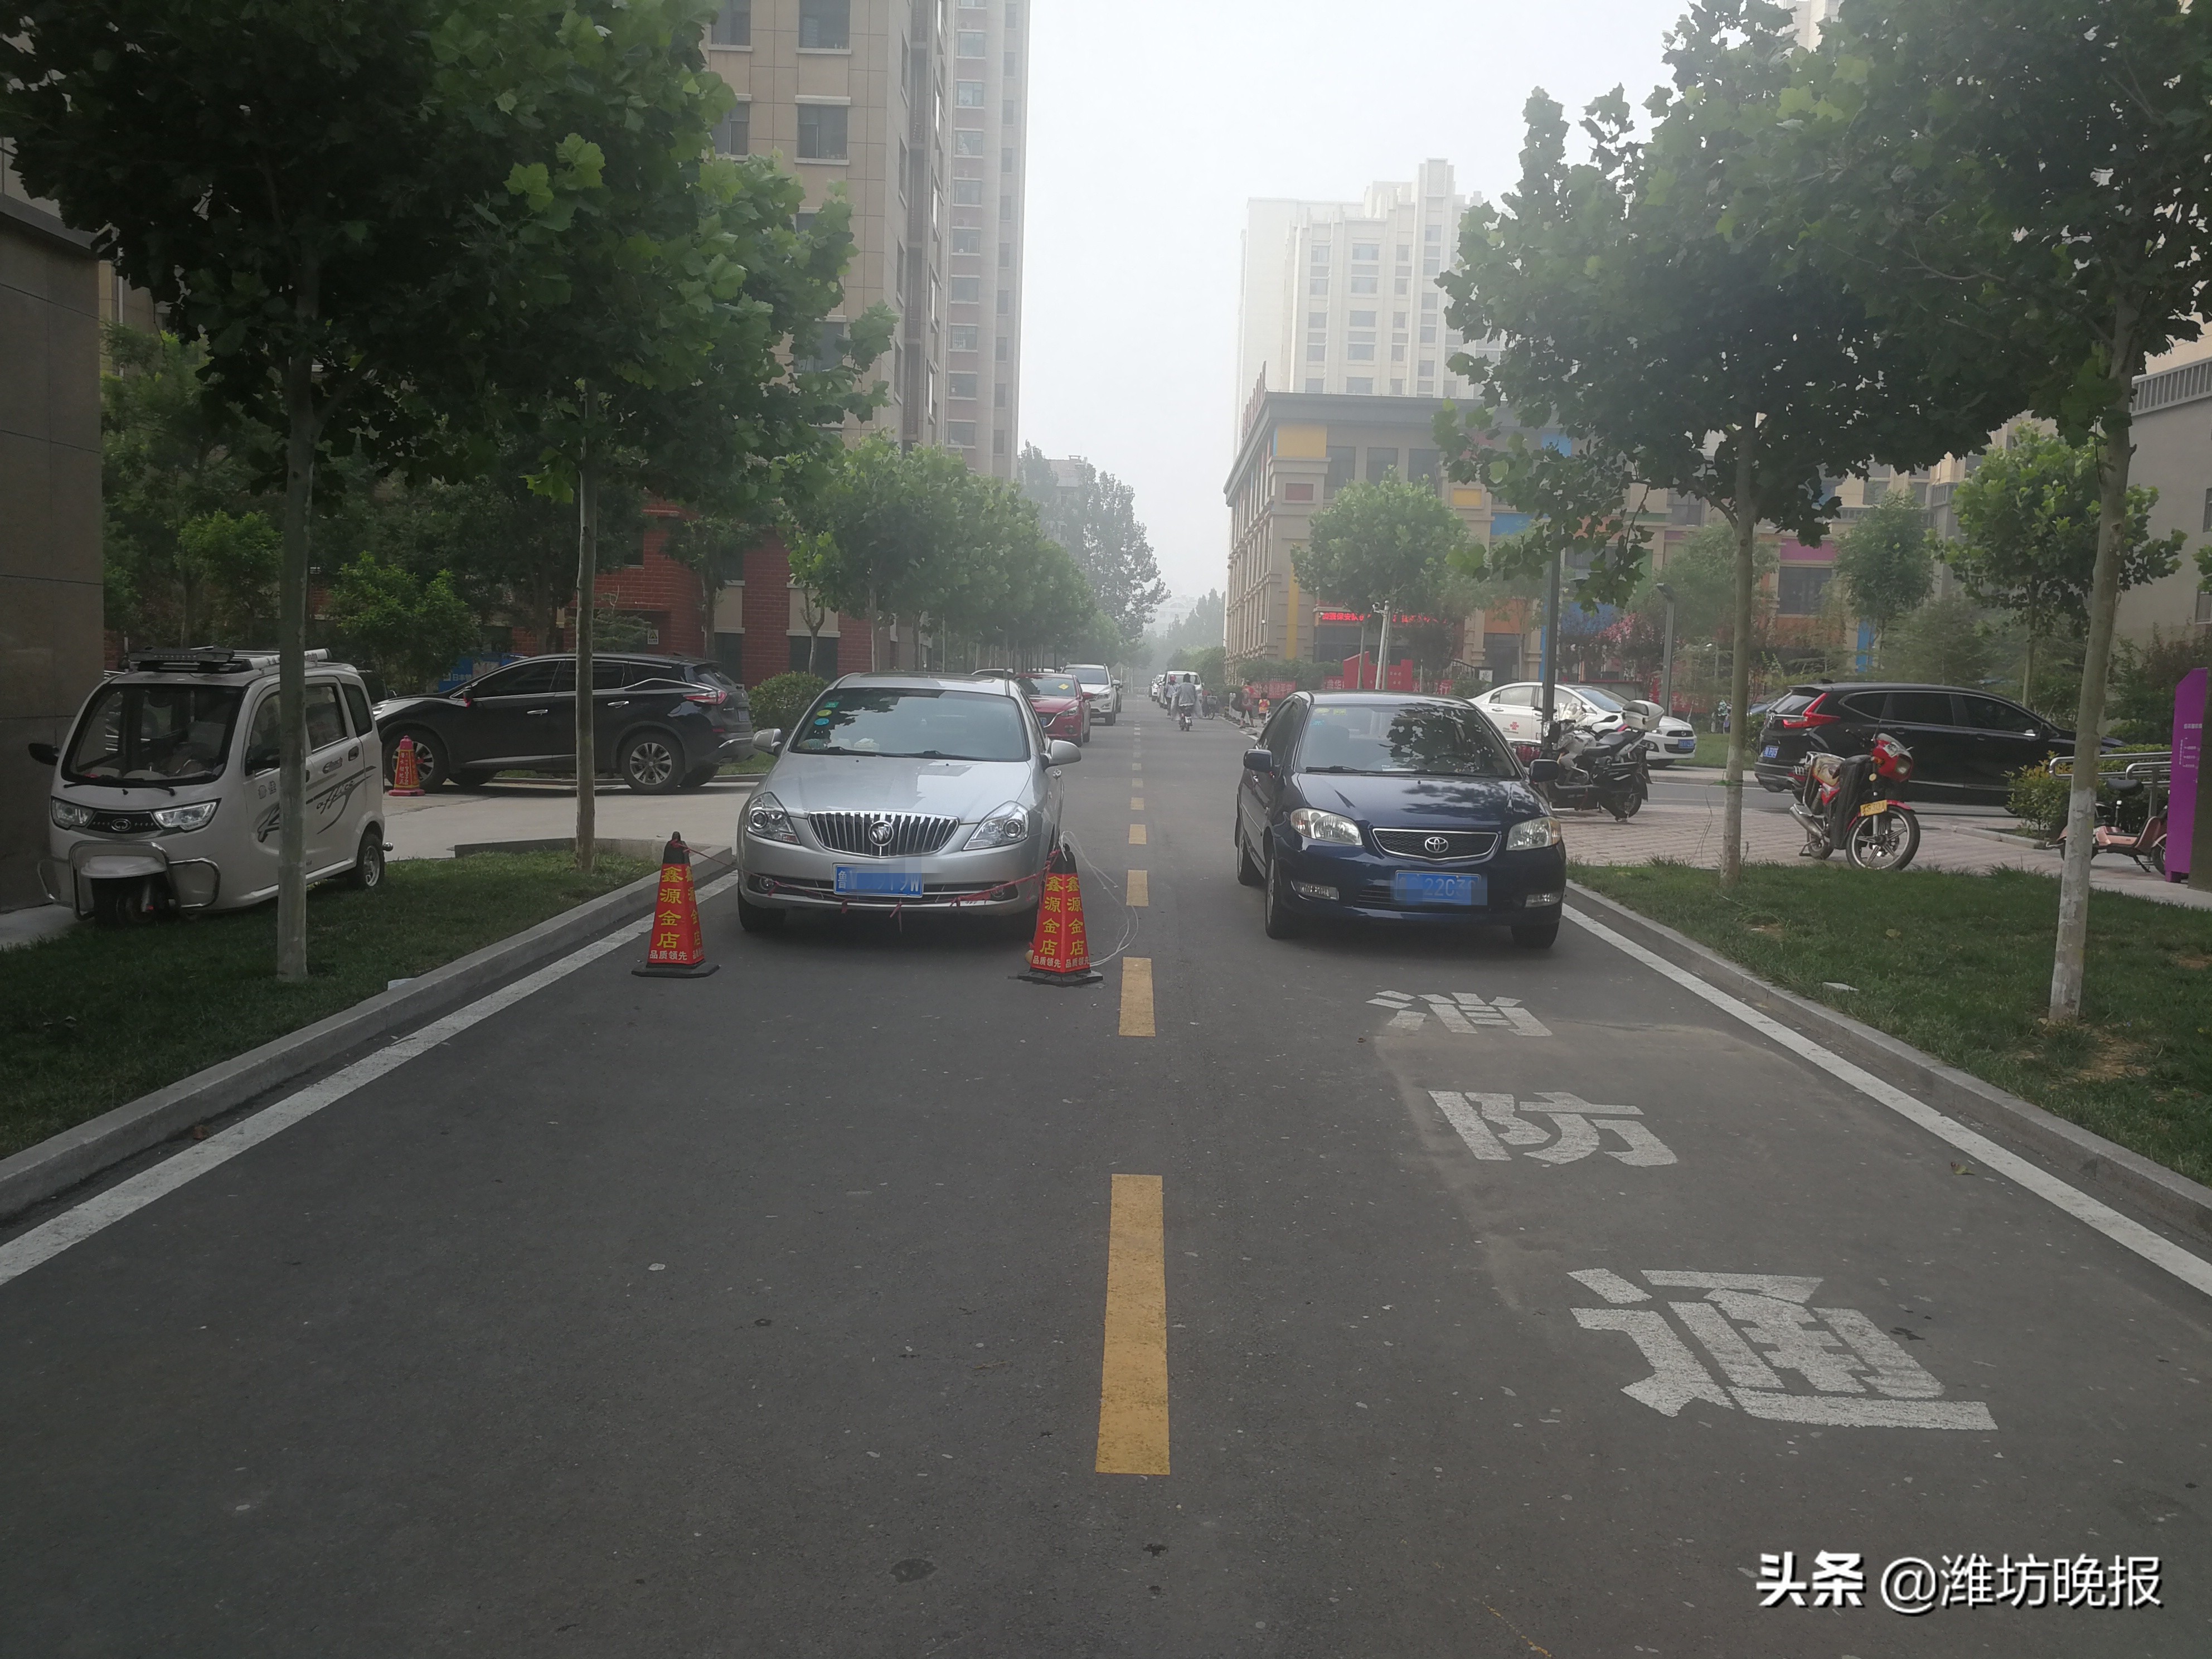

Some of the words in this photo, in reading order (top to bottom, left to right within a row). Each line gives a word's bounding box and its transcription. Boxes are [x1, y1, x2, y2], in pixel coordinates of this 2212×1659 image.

[657, 866, 683, 949] 鑫源金店
[1040, 876, 1064, 956] 鑫源金店
[1065, 876, 1084, 955] 鑫源金店
[649, 950, 688, 961] 品质领先
[1032, 955, 1061, 969] 品质领先
